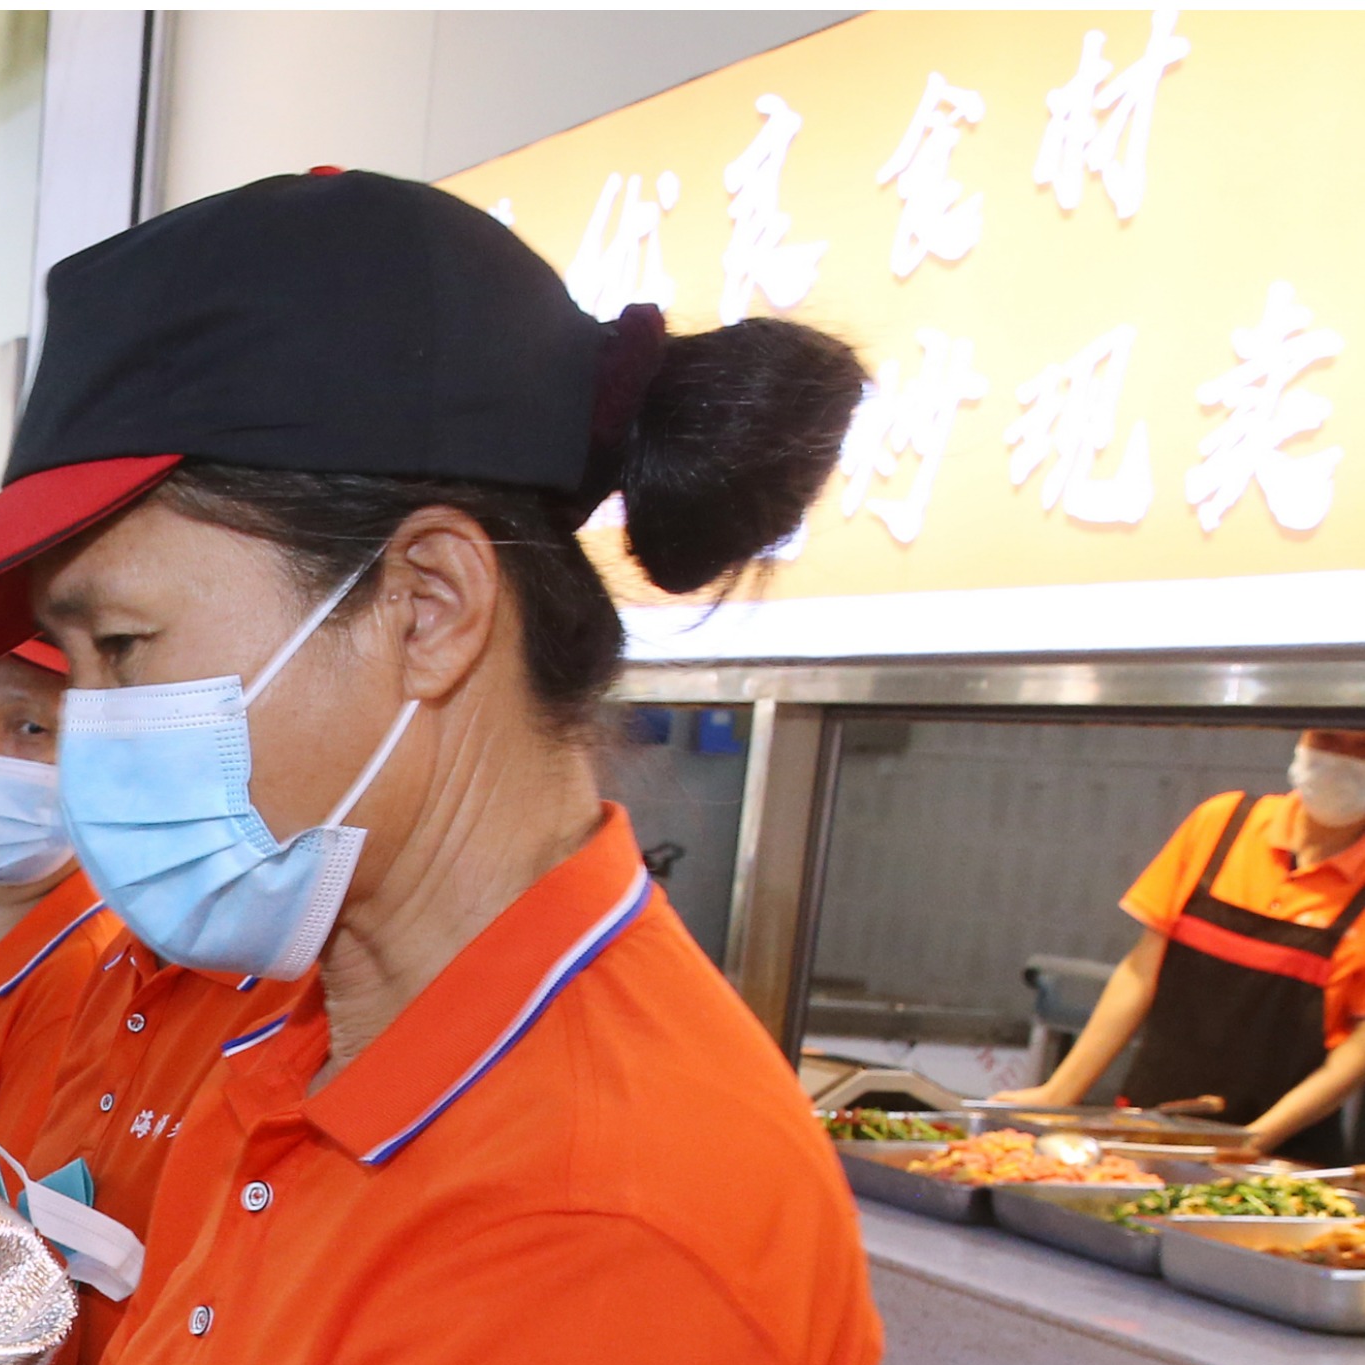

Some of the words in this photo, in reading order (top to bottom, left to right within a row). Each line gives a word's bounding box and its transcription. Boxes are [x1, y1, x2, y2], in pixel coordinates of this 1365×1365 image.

[488, 10, 1191, 325] 优良食材
[756, 282, 1345, 560] 炒现卖
